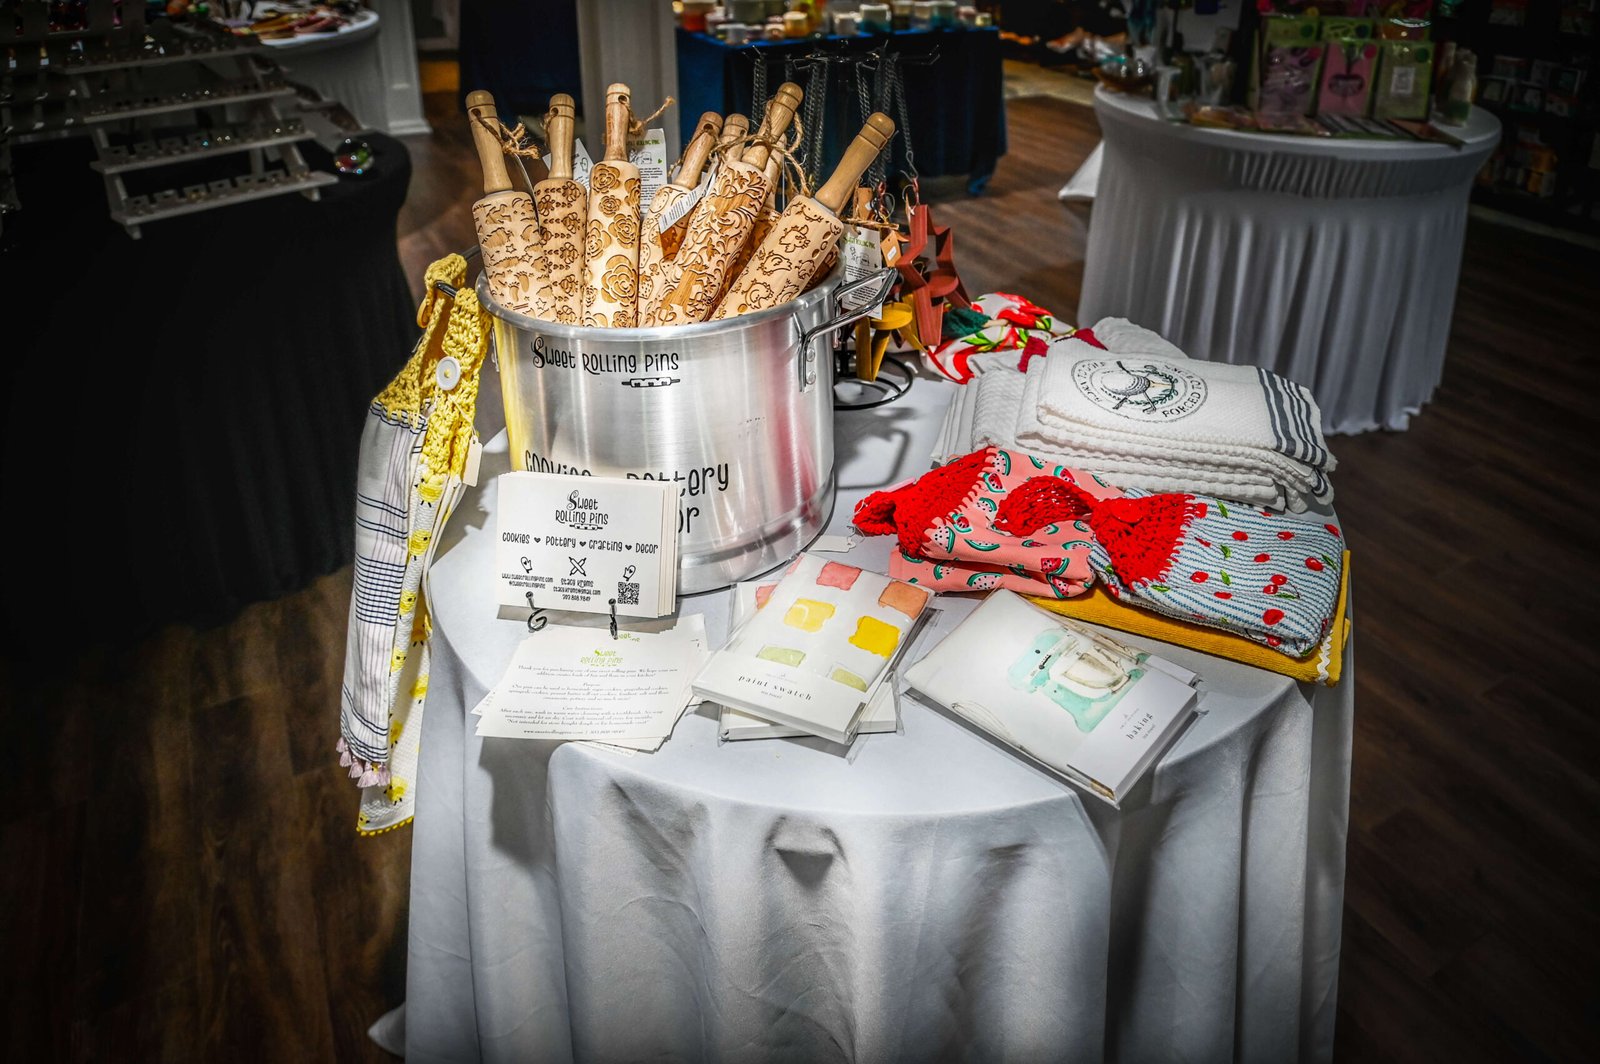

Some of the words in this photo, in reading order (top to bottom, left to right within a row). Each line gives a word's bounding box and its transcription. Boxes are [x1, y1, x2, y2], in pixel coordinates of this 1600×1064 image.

[530, 336, 576, 368] Sweet
[566, 490, 598, 511] Sweet
[738, 674, 768, 688] paint
[773, 683, 812, 701] swatch
[1126, 712, 1153, 740] baking
